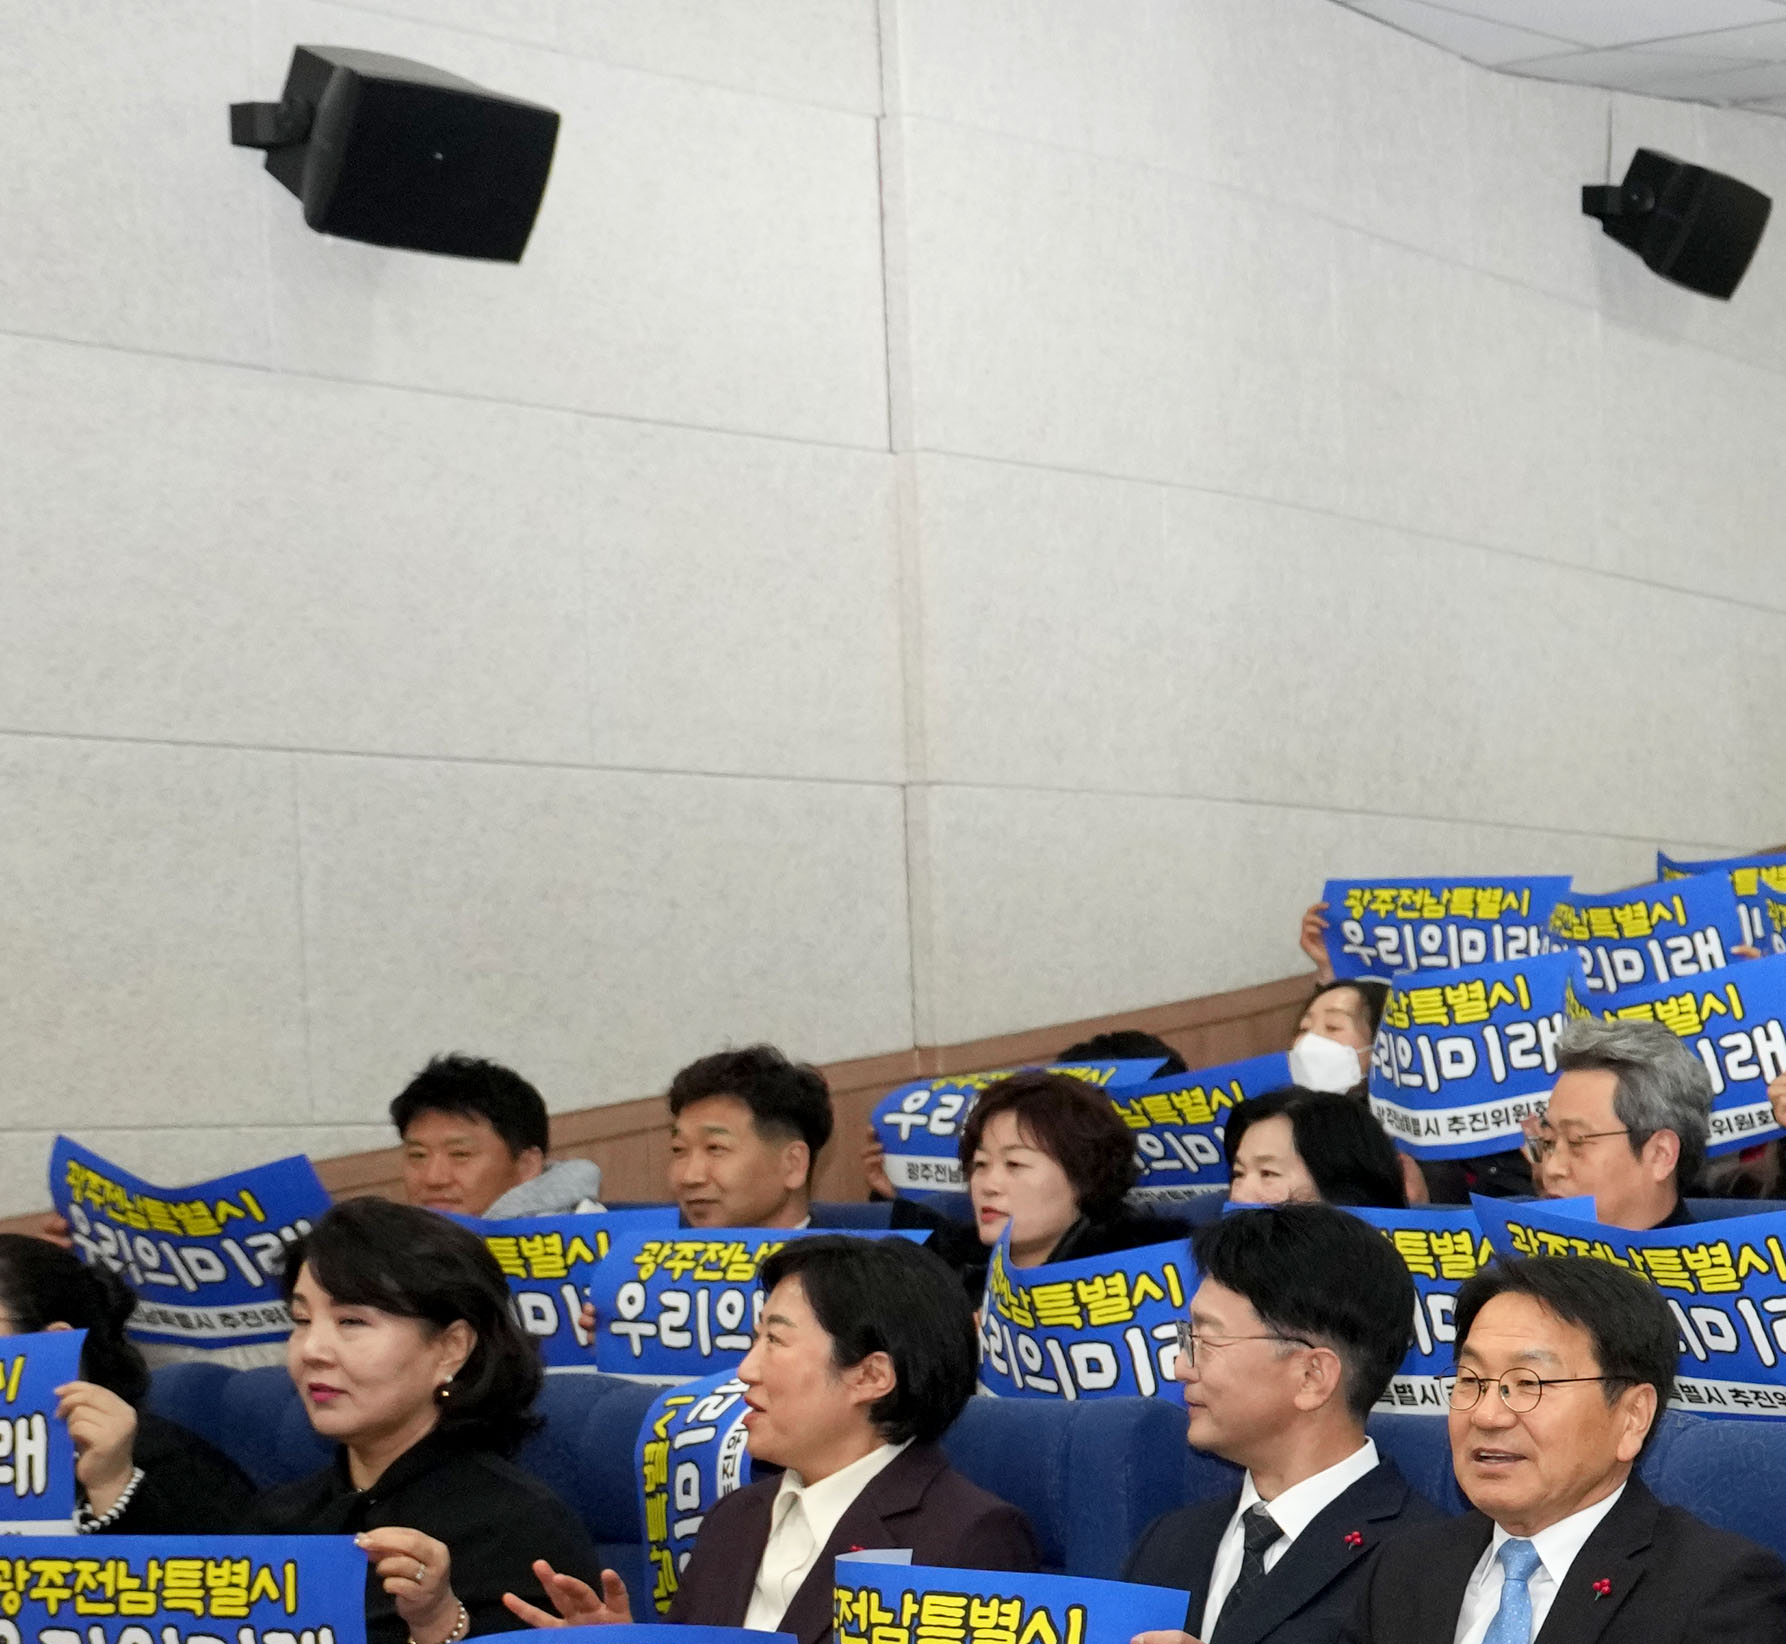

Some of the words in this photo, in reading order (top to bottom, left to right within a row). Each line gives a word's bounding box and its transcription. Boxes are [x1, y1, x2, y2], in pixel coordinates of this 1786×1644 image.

[1345, 887, 1531, 921] 광주전남특별시
[634, 1242, 784, 1282] 광주전남
[610, 1281, 764, 1358] 우리의
